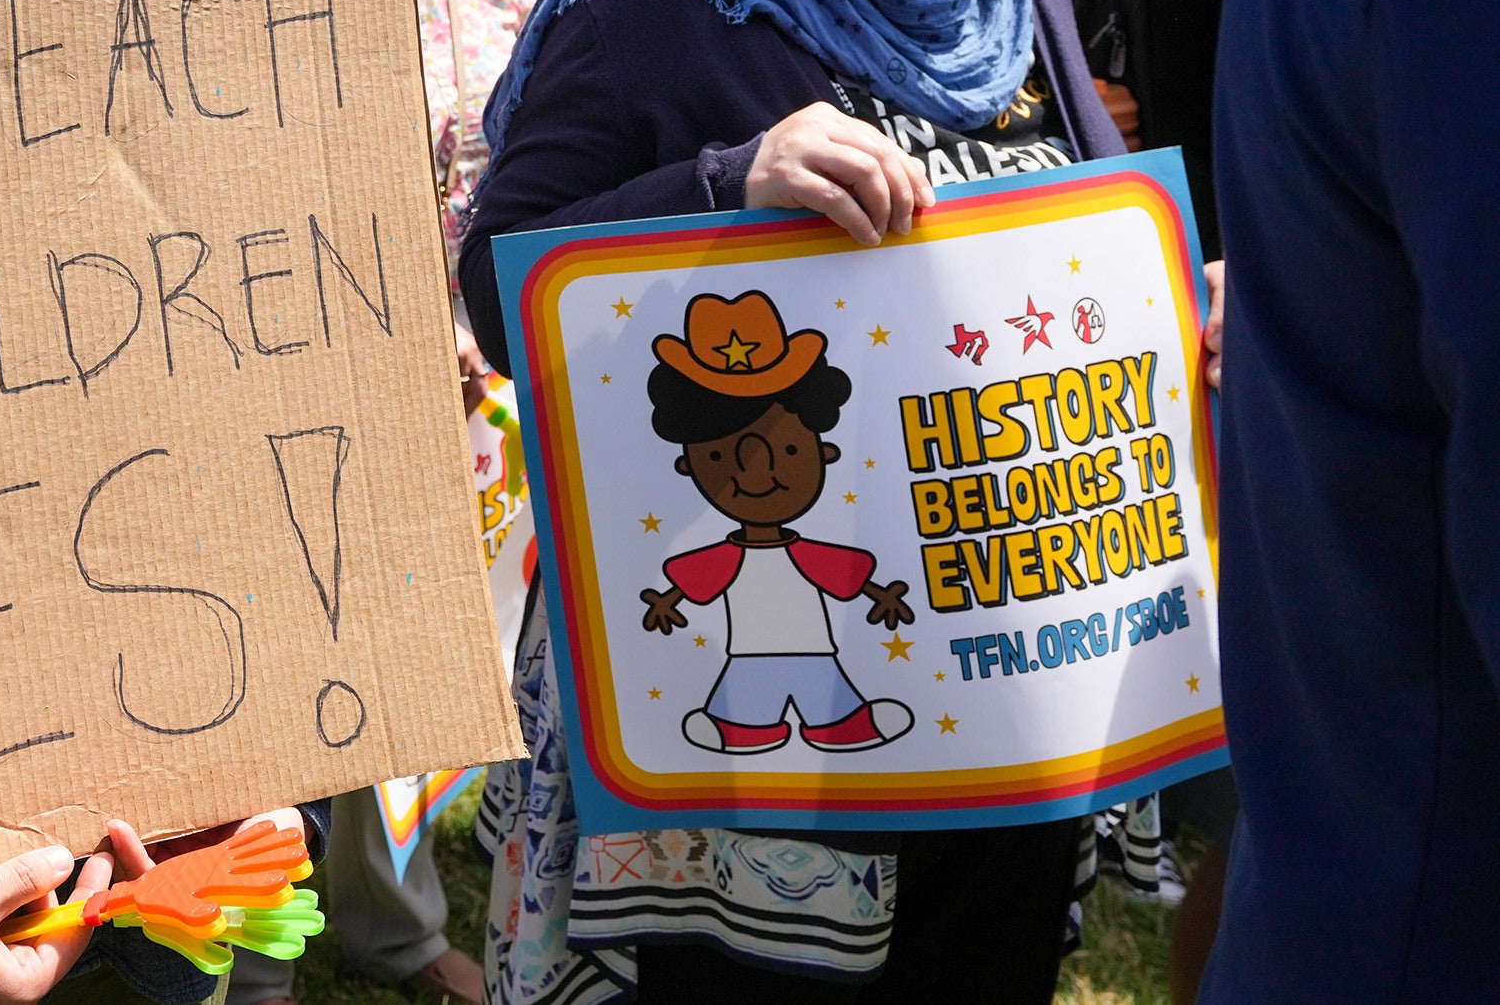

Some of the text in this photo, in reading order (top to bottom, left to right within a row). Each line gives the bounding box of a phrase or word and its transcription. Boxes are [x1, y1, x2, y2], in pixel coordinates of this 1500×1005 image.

[900, 351, 1157, 472] HISTORY
[911, 433, 1175, 538] BELONGS TO
[921, 493, 1189, 613] EVERYONE
[950, 586, 1190, 680] TFN.ORG/SBOE
